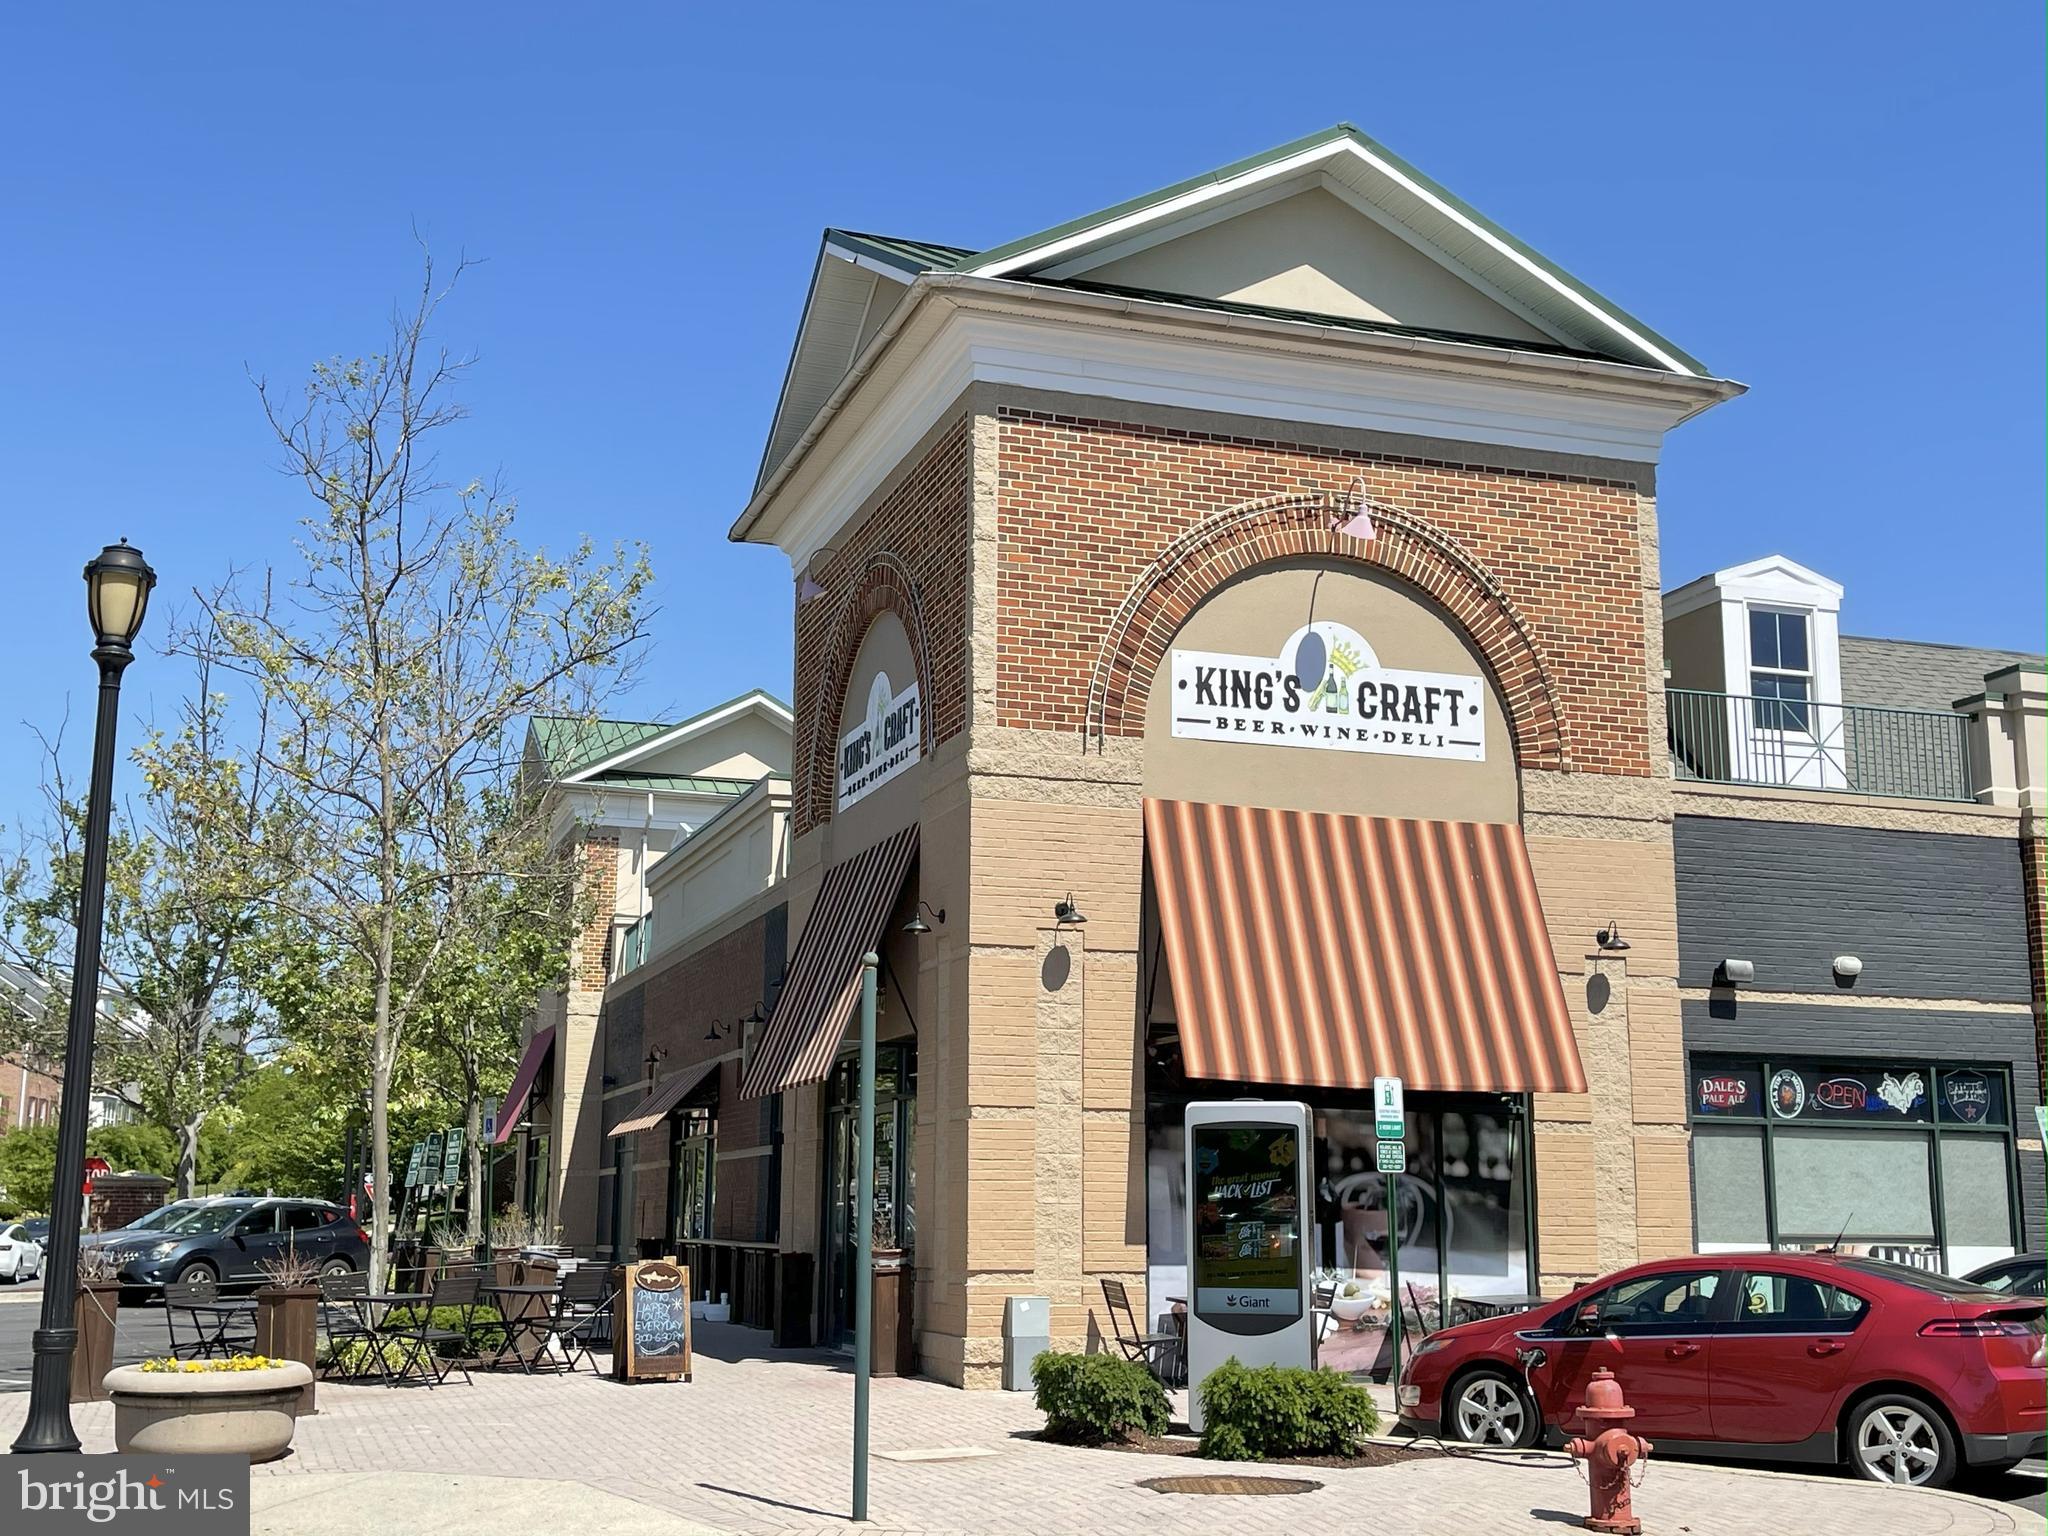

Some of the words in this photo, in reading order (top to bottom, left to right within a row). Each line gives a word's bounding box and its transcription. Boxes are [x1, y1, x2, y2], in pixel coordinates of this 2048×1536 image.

[1195, 666, 1302, 713] KING'S
[1357, 681, 1464, 727] CRAFT
[843, 730, 871, 780] KING'S
[884, 697, 916, 751] CRAFT
[1216, 716, 1286, 735] BEER
[1301, 725, 1369, 742] WINE
[1382, 731, 1444, 748] DELI
[1817, 1082, 1867, 1108] OPEN
[85, 1168, 109, 1184] TOP
[637, 1290, 669, 1302] PATIO
[1239, 1296, 1271, 1308] Giant
[636, 1302, 671, 1314] HAPPY
[635, 1319, 683, 1331] EVERYDAY
